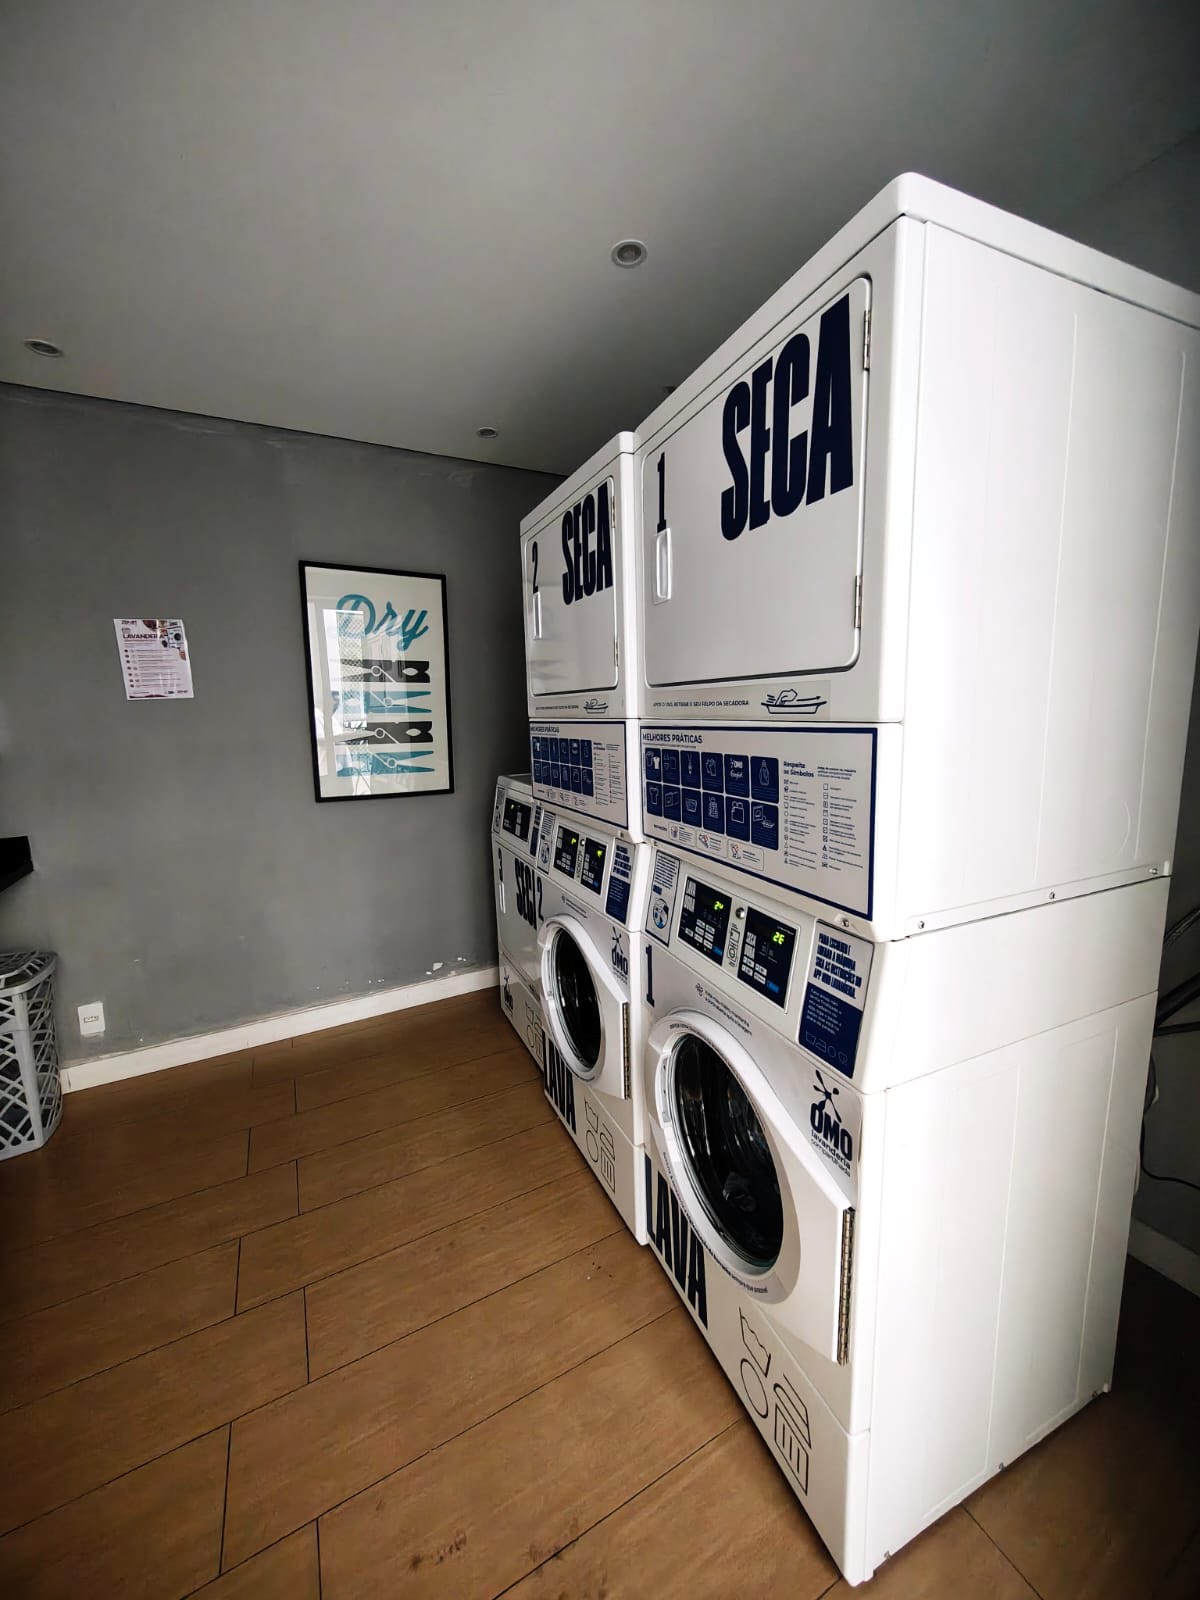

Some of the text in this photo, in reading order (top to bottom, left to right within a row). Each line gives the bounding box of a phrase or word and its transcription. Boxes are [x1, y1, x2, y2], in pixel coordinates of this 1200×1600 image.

[721, 293, 853, 541] SECA
[656, 452, 667, 533] 1
[532, 541, 539, 594] 2
[562, 481, 613, 605] SECA
[336, 593, 429, 651] Dry
[643, 733, 703, 744] MELHORES PRÁTICAS
[537, 876, 544, 921] 2
[612, 944, 628, 975] OMO
[646, 944, 655, 1007] 1
[542, 1029, 577, 1134] LAVA
[810, 1101, 852, 1162] OMO
[811, 1129, 851, 1170] lavanderia
[645, 1152, 708, 1330] LAVA
